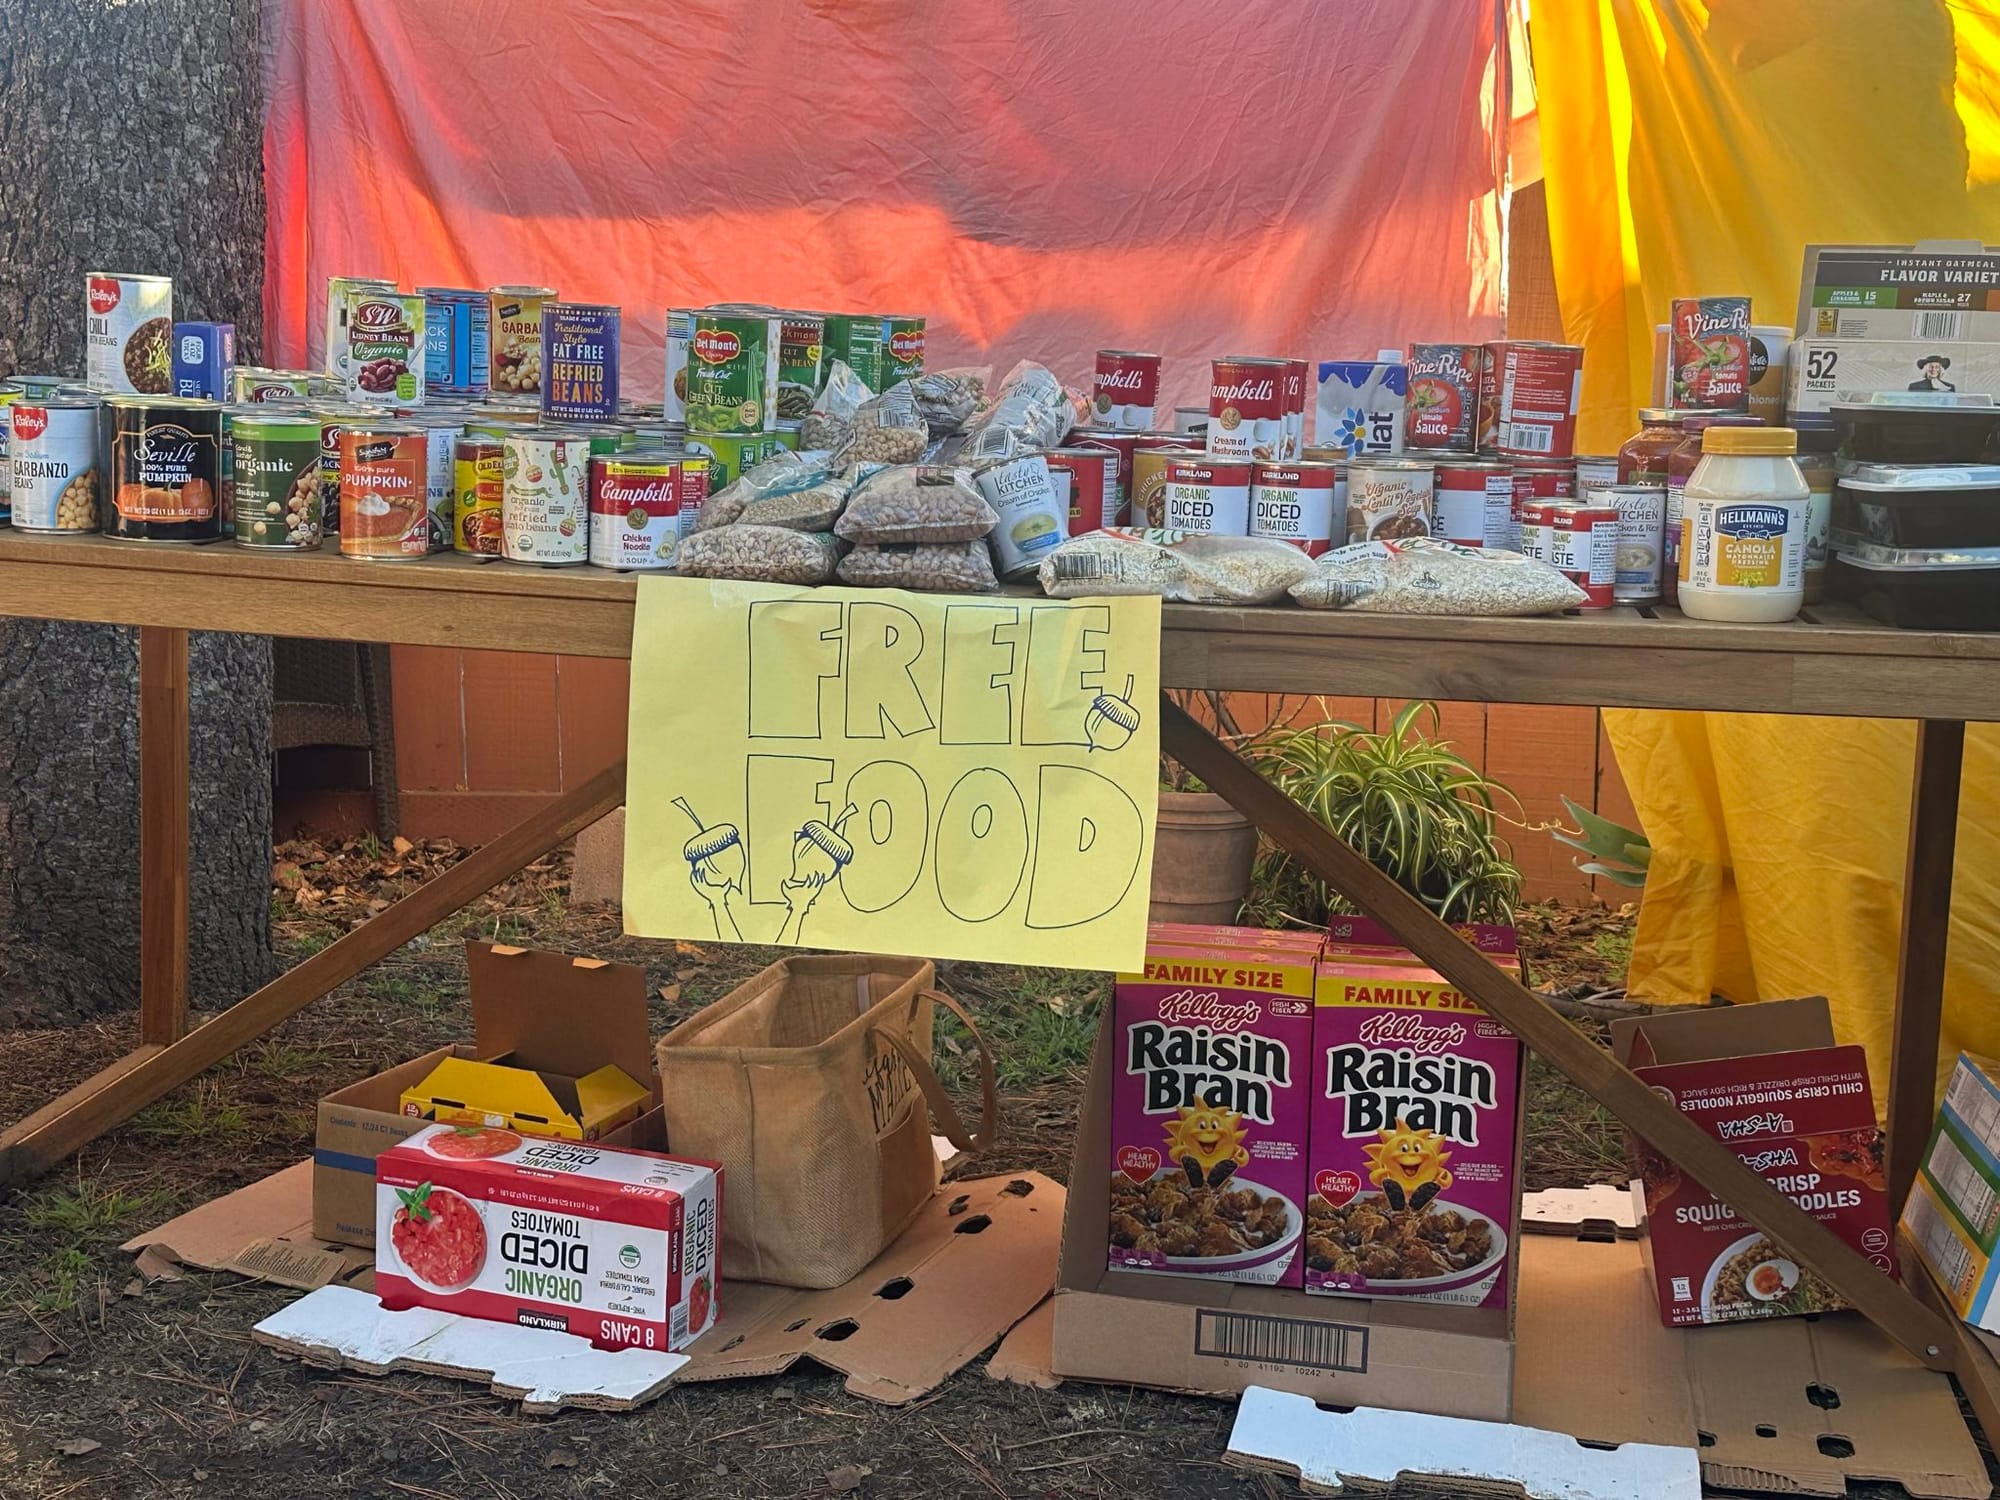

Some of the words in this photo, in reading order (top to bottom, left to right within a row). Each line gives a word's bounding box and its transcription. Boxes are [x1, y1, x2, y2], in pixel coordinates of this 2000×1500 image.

[1896, 259, 1942, 268] INSTANT
[1945, 260, 1996, 269] OATMEAL
[1880, 269, 1939, 282] FLAVOR
[1864, 291, 1877, 301] 15
[1957, 293, 1972, 302] 27
[89, 317, 108, 336] CHILI
[502, 321, 542, 334] GARBA
[554, 322, 604, 334] Traditional
[1684, 313, 1731, 339] Vine
[1731, 304, 1751, 339] Rip
[381, 333, 409, 343] BEANS
[562, 333, 587, 345] Style
[696, 337, 708, 348] Del
[709, 340, 738, 351] Monte
[353, 343, 404, 360] Organic
[553, 343, 571, 358] FAT
[576, 344, 605, 360] FREE
[552, 363, 604, 382] REFRIED
[1438, 350, 1474, 383] Ripe
[1806, 350, 1839, 380] 52
[1095, 368, 1143, 391] mpbell's
[1715, 372, 1738, 380] tomato
[703, 382, 723, 395] CUT
[1211, 379, 1274, 404] ampbell's
[1707, 380, 1742, 397] Sauce
[1805, 380, 1837, 389] PACKETS
[552, 381, 603, 404] BEANS
[689, 391, 713, 405] GREEN
[714, 393, 743, 406] BEANS
[14, 413, 46, 432] Raley's
[1415, 419, 1448, 435] Sauce
[1213, 436, 1236, 446] Cream
[1237, 436, 1248, 446] of
[133, 438, 199, 463] Seville
[1211, 446, 1250, 457] Mushroom
[14, 460, 69, 479] GARBANZO
[141, 463, 164, 472] 100%
[165, 464, 188, 472] PURE
[235, 458, 294, 477] organic
[354, 465, 375, 473] 100%
[1175, 468, 1213, 479] KIRKLAND
[138, 472, 192, 483] PUMPKIN
[344, 474, 408, 488] PUMPKIN
[1262, 471, 1300, 481] KIRKLAND
[14, 478, 34, 490] BEANS
[998, 475, 1045, 496] KITCHEN
[1139, 471, 1168, 502] CHICKE
[1364, 481, 1407, 498] Organic
[235, 488, 270, 498] chickpeas
[600, 479, 674, 506] Campbell's
[1174, 487, 1211, 501] ORGANIC
[1260, 488, 1298, 503] ORGANIC
[510, 497, 545, 508] organic
[1171, 500, 1214, 517] DICED
[1360, 494, 1394, 513] Lentil
[509, 513, 548, 523] refried
[1256, 502, 1301, 520] DICED
[1397, 503, 1422, 519] Soup
[1620, 510, 1659, 521] TCHEN
[1719, 510, 1786, 526] HELLMANN'S
[525, 524, 558, 533] beans
[1171, 517, 1212, 530] TOMATOES
[1257, 519, 1299, 532] TOMATOES
[622, 533, 652, 543] Chicken
[623, 542, 651, 551] Noodle
[1725, 543, 1776, 554] CANOLA
[626, 557, 648, 565] SOUP
[747, 600, 1111, 748] FREE
[747, 754, 1144, 930] FOOD
[1144, 963, 1229, 985] FAMILY
[1234, 970, 1283, 989] SIZE
[1344, 985, 1434, 1007] FAMILY
[1158, 989, 1262, 1032] Kellogg's
[1358, 1011, 1467, 1054] Kellogg's
[1477, 1021, 1497, 1029] HIGH
[1477, 1028, 1499, 1036] FIBER
[1131, 1023, 1289, 1084] Raisin
[1329, 1046, 1493, 1106] Raisin
[1791, 1076, 1817, 1087] CRISP
[1817, 1074, 1841, 1084] CHILI
[1840, 1071, 1863, 1081] WITH
[1709, 1086, 1727, 1096] SOY
[1727, 1084, 1747, 1094] RICH
[1748, 1083, 1756, 1091] &
[1756, 1078, 1791, 1090] DRIZZLE
[1832, 1082, 1864, 1096] CHILI
[1147, 1068, 1270, 1121] Bran
[1681, 1087, 1709, 1099] SAUCE
[1735, 1089, 1793, 1106] SQUIGGLY
[1794, 1085, 1830, 1100] CRISP
[1680, 1095, 1735, 1112] NOODLES
[1347, 1091, 1475, 1143] Bran
[1717, 1112, 1784, 1139] A-SHA
[524, 1146, 600, 1166] DICED
[543, 1142, 601, 1156] TOMATOES
[1127, 1151, 1153, 1162] HEART
[515, 1155, 582, 1173] ORGANIC
[1123, 1158, 1156, 1170] HEALTHY
[1738, 1147, 1799, 1172] -SHA
[1321, 1182, 1356, 1193] HEALTHY
[1325, 1176, 1352, 1186] HEART
[1766, 1173, 1821, 1193] RISP
[619, 1184, 654, 1198] CANS
[1675, 1203, 1735, 1225] SQUIG
[1789, 1189, 1862, 1212] ODLES
[511, 1210, 582, 1239] TOMATOES
[707, 1198, 715, 1256] TOMATOES
[1701, 1224, 1720, 1232] WITH
[1816, 1212, 1837, 1221] SAUCE
[683, 1209, 697, 1277] ORGANIC
[695, 1198, 708, 1273] DICED
[500, 1231, 589, 1275] DICED
[504, 1267, 583, 1304] ORGANIC
[1677, 1283, 1686, 1291] 12
[519, 1314, 567, 1331] KIRKLAND
[600, 1319, 641, 1345] CANS
[645, 1327, 655, 1348] 8
[1223, 1359, 1230, 1367] 0
[1238, 1360, 1249, 1369] 00
[1295, 1367, 1321, 1377] 10242
